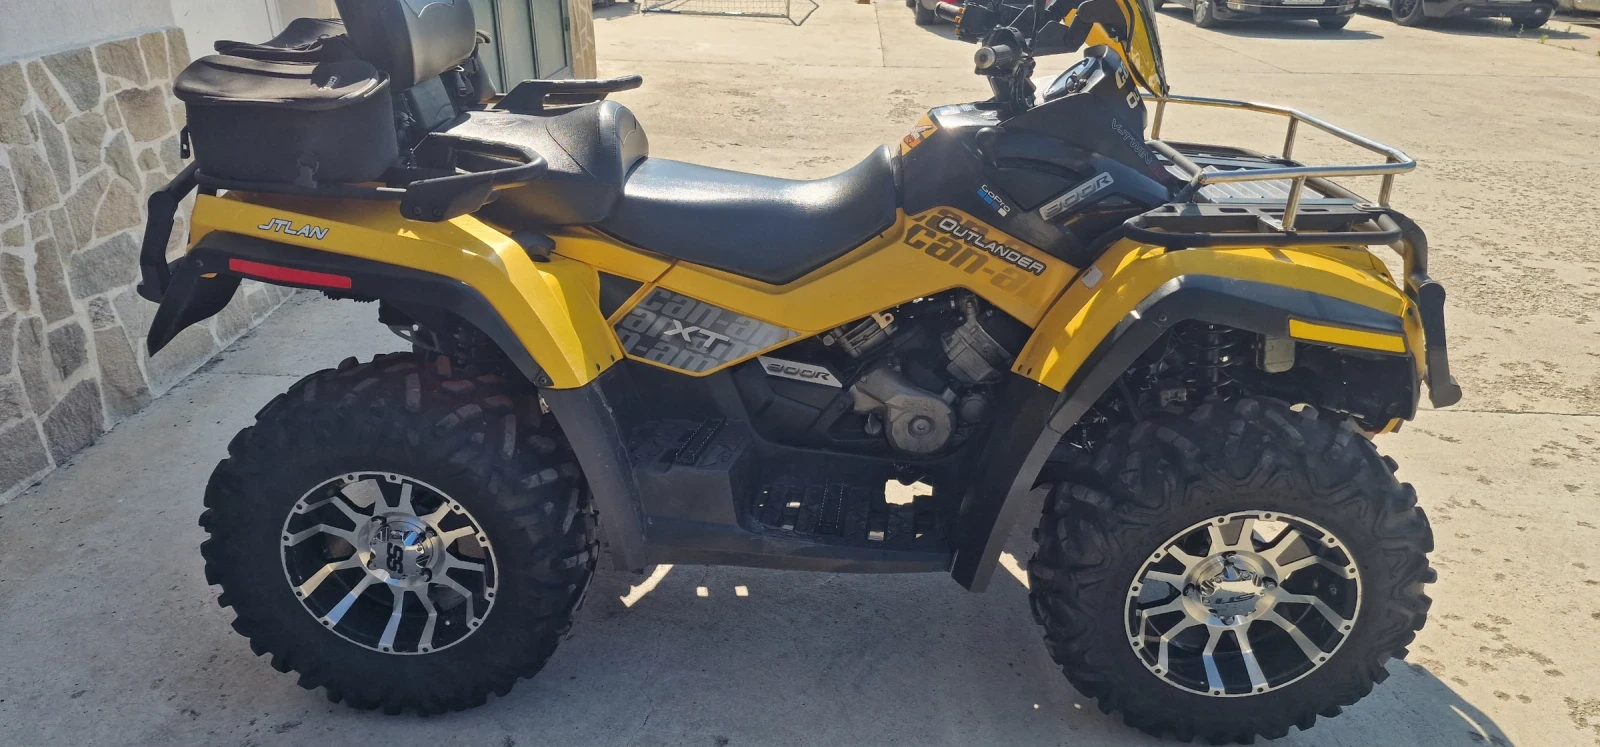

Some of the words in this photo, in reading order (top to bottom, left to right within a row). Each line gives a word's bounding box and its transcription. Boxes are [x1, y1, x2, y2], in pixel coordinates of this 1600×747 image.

[981, 184, 1011, 213] GoPro
[1045, 175, 1111, 218] 800R
[938, 216, 1045, 275] OUTLANDER
[663, 319, 731, 349] XT
[766, 363, 830, 381] 800R
